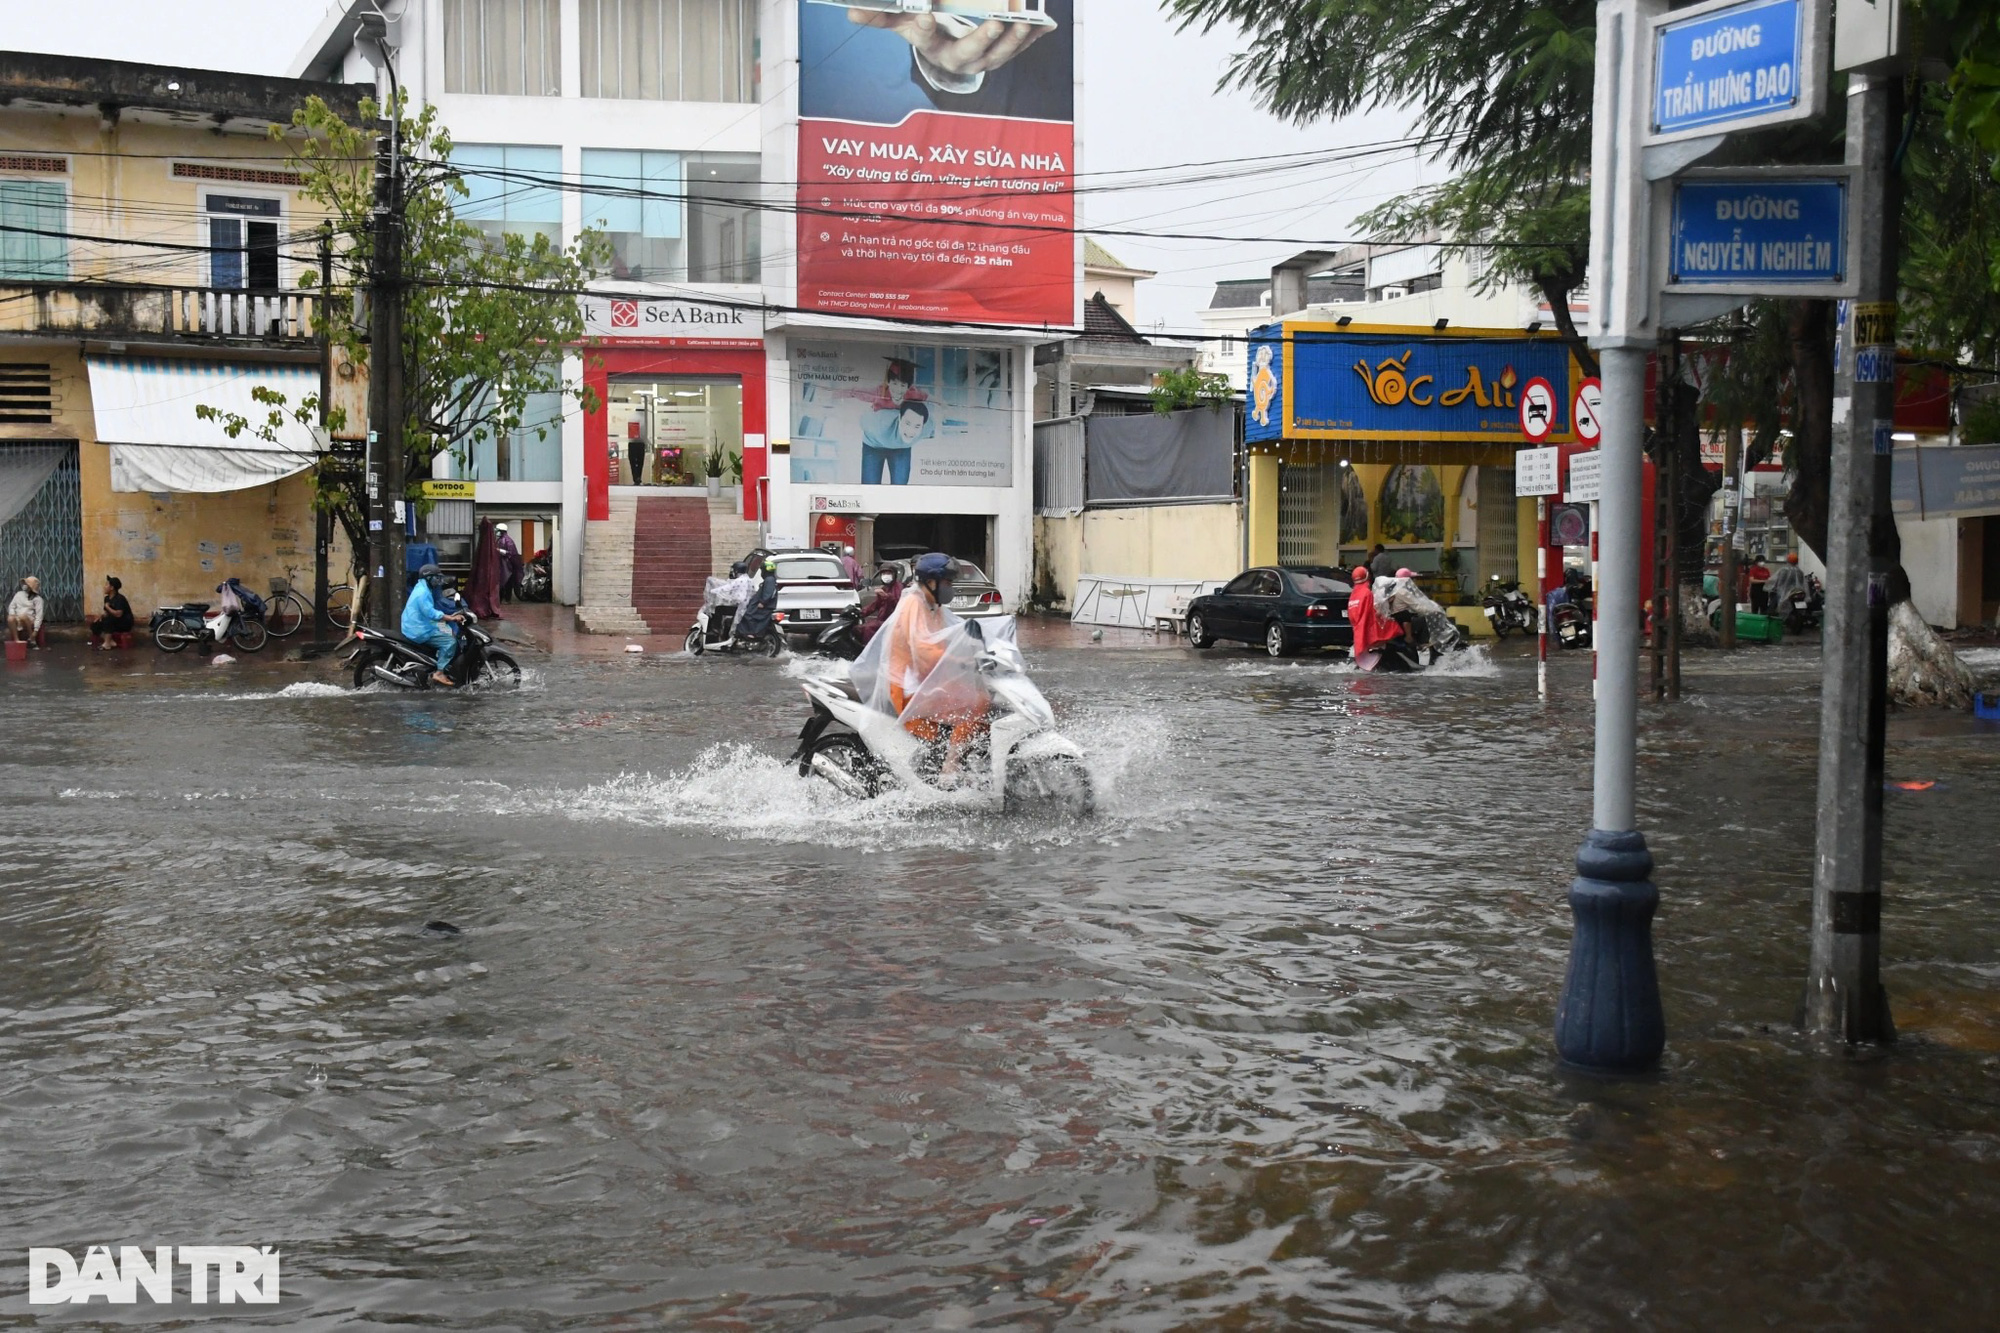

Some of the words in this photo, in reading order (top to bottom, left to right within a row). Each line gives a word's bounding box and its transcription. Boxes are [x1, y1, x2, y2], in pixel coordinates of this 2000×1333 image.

[1690, 24, 1761, 61] ĐƯỜNG
[1663, 71, 1704, 119] TRẦN
[1707, 69, 1752, 110] HƯNG
[1755, 62, 1790, 105] ĐẠO
[821, 137, 865, 157] VAY
[870, 142, 924, 164] MUA,
[928, 143, 968, 165] XÂY
[973, 146, 1016, 169] SỬA
[1020, 152, 1066, 172] NHÀ
[856, 167, 891, 183] dựng
[894, 168, 908, 182] tổ
[910, 171, 935, 186] ấm,
[1001, 179, 1040, 194] tương
[890, 203, 907, 214] vay
[925, 203, 939, 214] đa
[940, 205, 964, 215] 90%
[965, 208, 1004, 220] phương
[1006, 208, 1019, 219] án
[1022, 212, 1039, 223] vay
[1041, 213, 1067, 223] mua,
[1715, 194, 1800, 220] ĐƯỜNG
[859, 233, 879, 246] hạn
[882, 234, 897, 246] trả
[899, 237, 913, 250] nợ
[915, 236, 934, 250] gốc
[951, 240, 965, 251] đa
[967, 241, 977, 251] 12
[1684, 228, 1756, 271] NGUYỄN
[1761, 233, 1831, 271] NGHIÊM
[841, 246, 854, 258] và
[856, 247, 877, 259] thời
[879, 249, 899, 262] hạn
[902, 252, 920, 263] vay
[937, 253, 950, 263] đa
[952, 253, 972, 265] đến
[974, 256, 987, 266] 25
[988, 255, 1013, 267] năm
[818, 289, 845, 299] Contact
[869, 292, 885, 300] 1900
[885, 293, 897, 301] 555
[830, 300, 849, 308] TMCP
[869, 302, 885, 310] Nam
[645, 306, 744, 324] SeABank
[828, 499, 861, 508] SeABank
